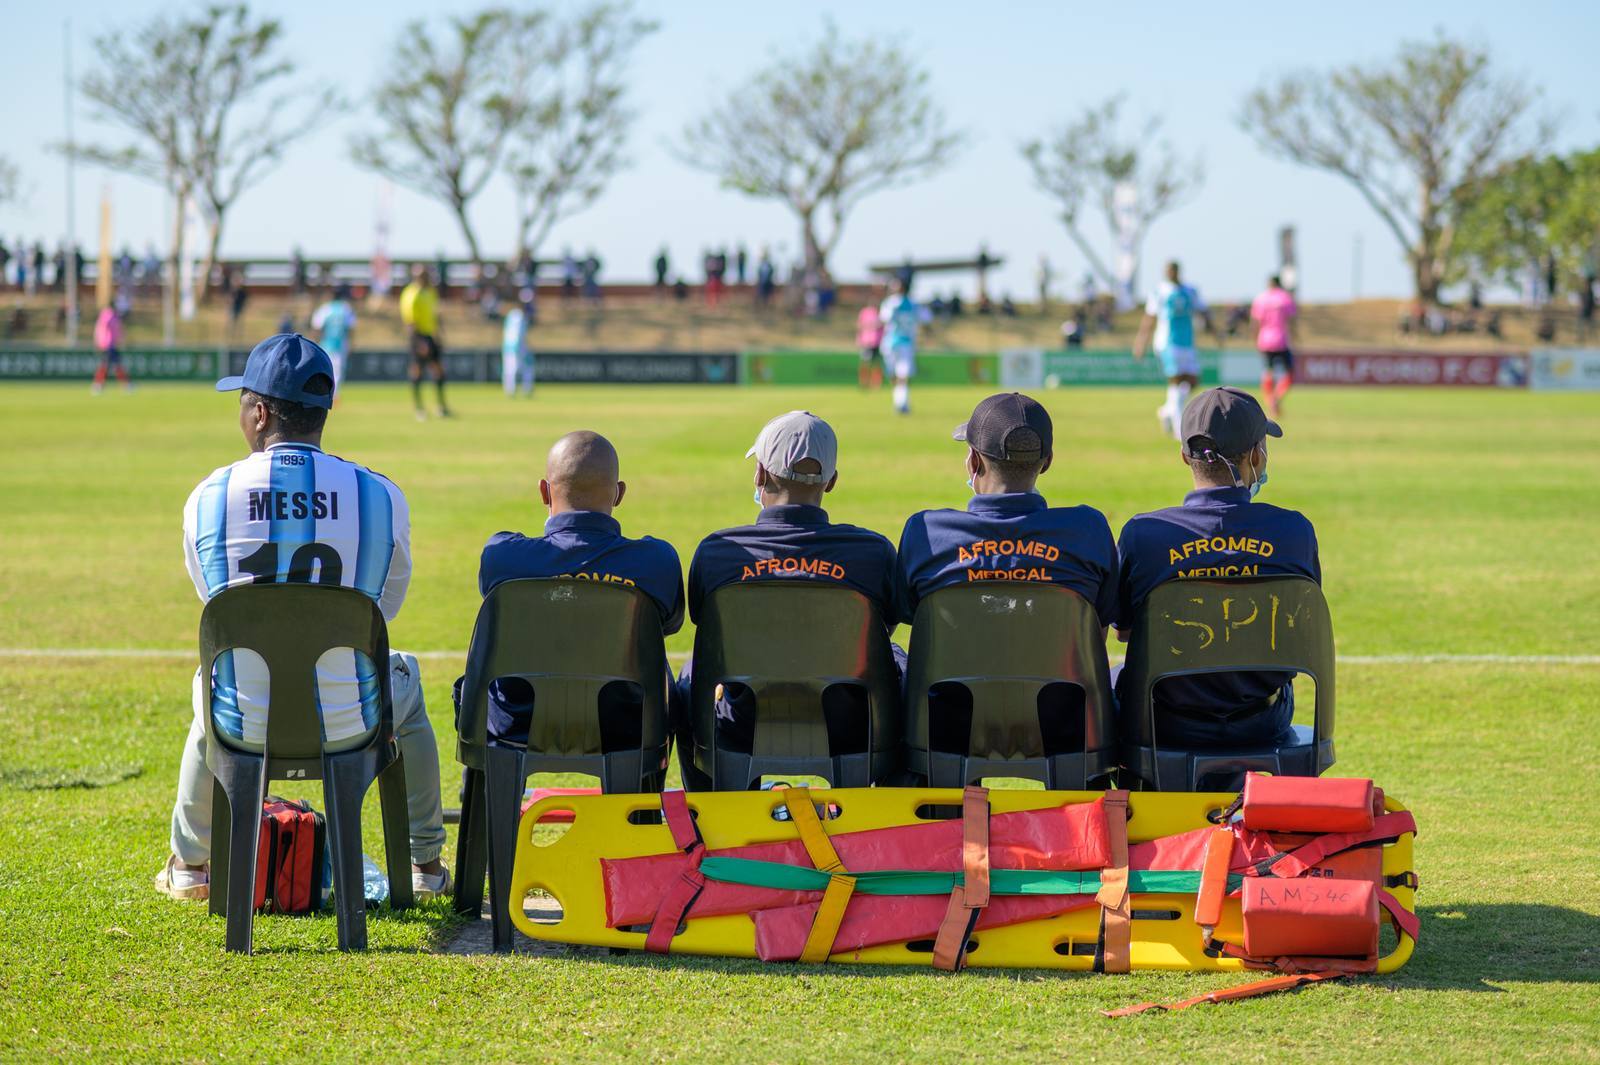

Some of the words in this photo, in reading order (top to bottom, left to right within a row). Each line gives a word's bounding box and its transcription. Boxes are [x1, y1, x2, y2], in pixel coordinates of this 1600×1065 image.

[1305, 357, 1440, 382] MILFORD
[280, 455, 306, 466] 1893
[249, 491, 338, 521] MESSI
[958, 539, 1060, 564] AFROMED
[1169, 536, 1275, 565] AFROMED
[741, 557, 846, 581] AFROMED
[967, 567, 1053, 582] MEDICAL
